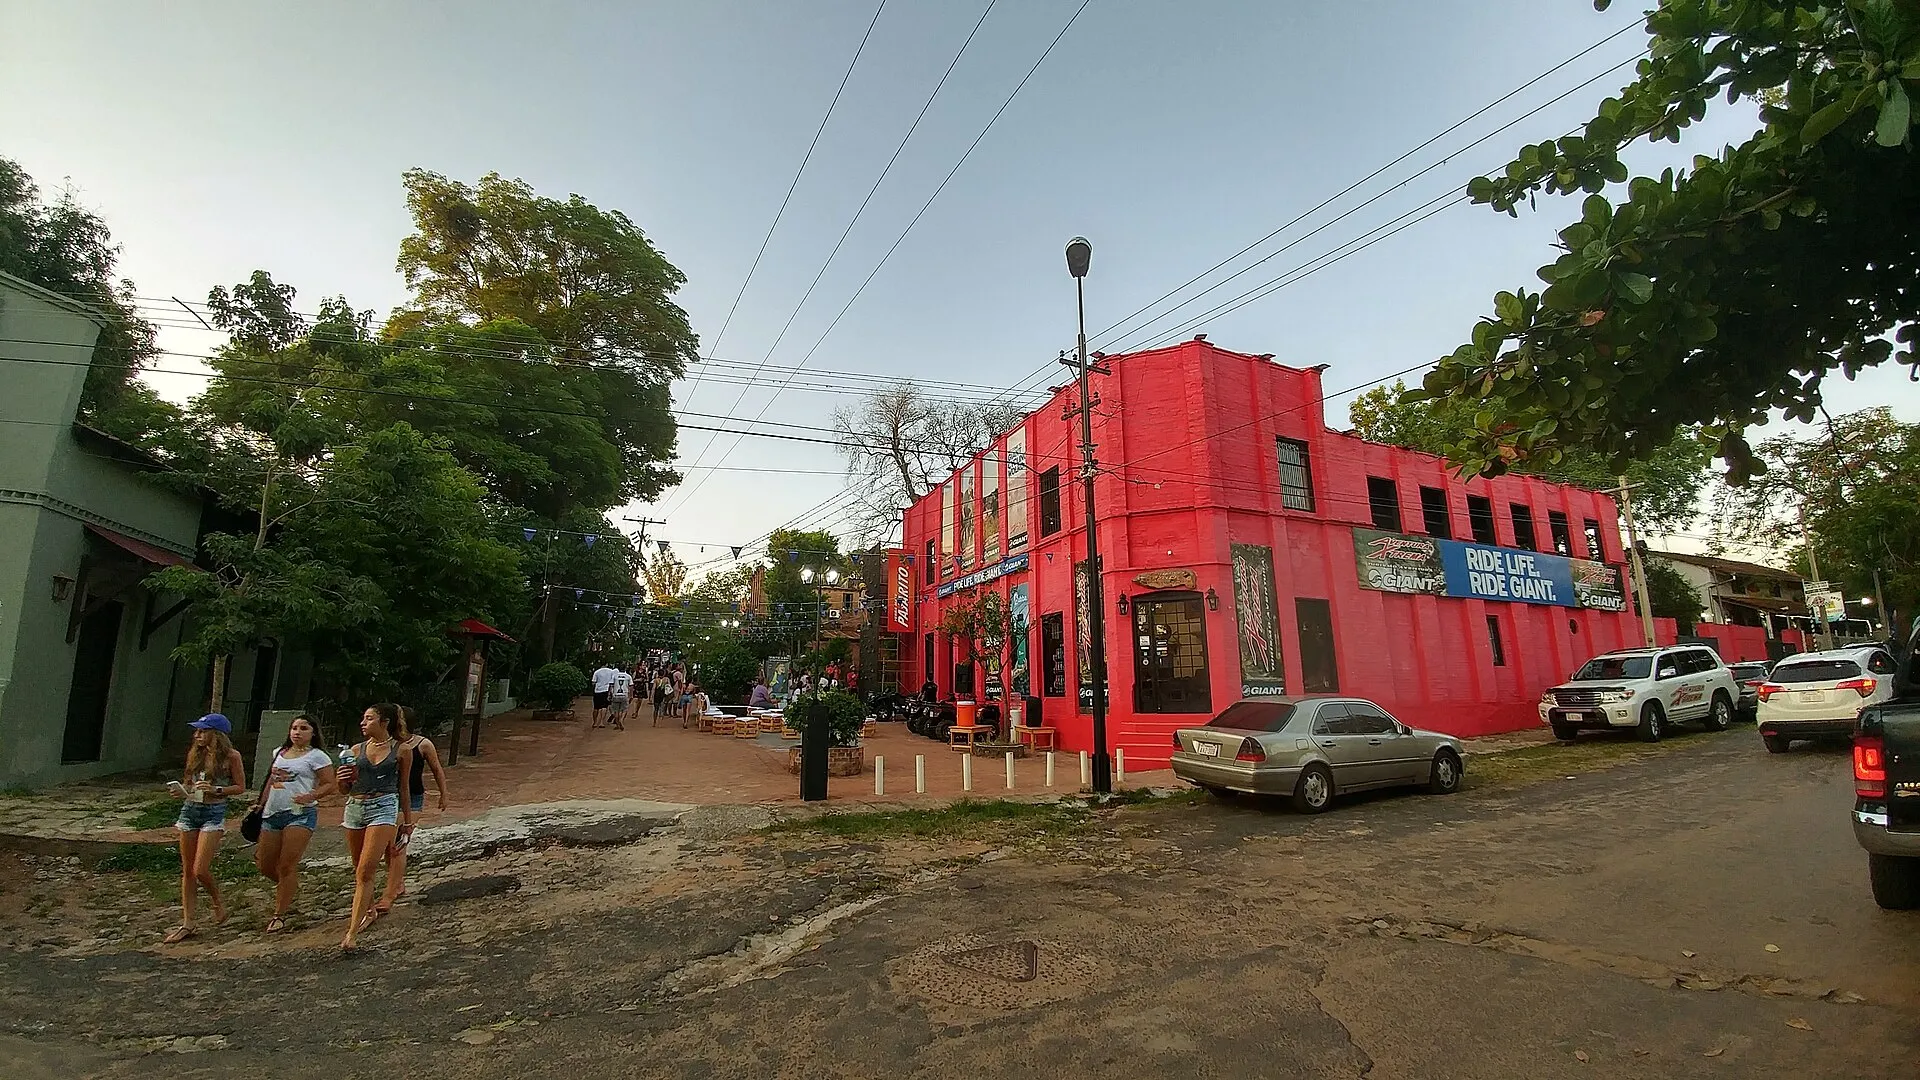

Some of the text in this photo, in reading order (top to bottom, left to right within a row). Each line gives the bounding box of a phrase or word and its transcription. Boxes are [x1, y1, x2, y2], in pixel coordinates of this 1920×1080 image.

[1465, 548, 1540, 577] RIDE LIFE.
[1383, 574, 1436, 591] GIANT
[1469, 572, 1557, 601] RIDE GIANT.
[897, 566, 909, 628] PAJARITO
[1590, 595, 1621, 608] GIANT
[1085, 688, 1109, 697] GIT
[1250, 686, 1284, 696] GIANT
